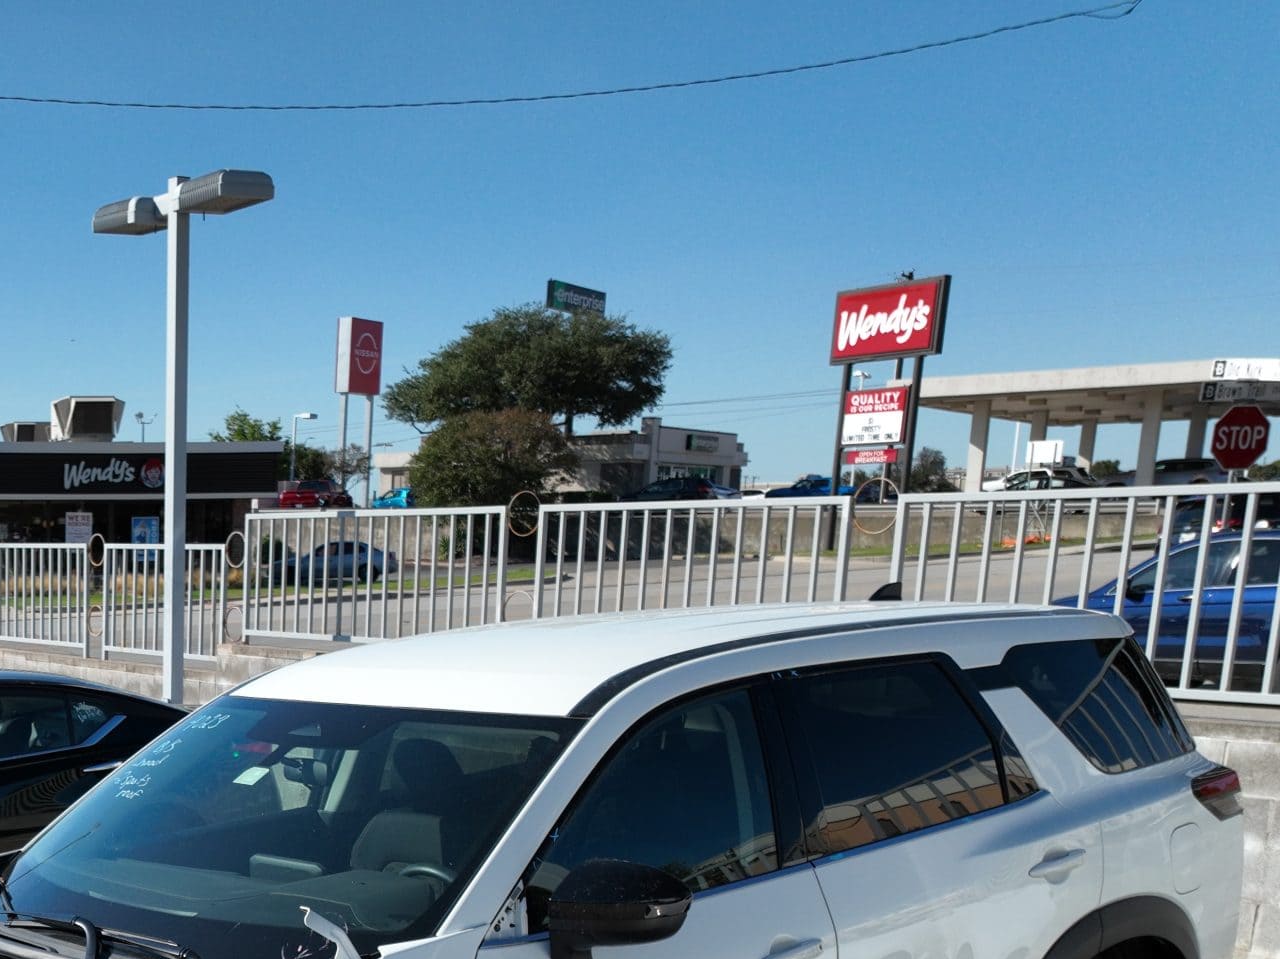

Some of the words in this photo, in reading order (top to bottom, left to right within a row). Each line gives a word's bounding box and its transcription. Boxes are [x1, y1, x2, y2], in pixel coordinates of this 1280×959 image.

[838, 293, 930, 351] Wendy's
[851, 392, 900, 406] QUALITY
[859, 404, 874, 412] OUR
[874, 403, 899, 411] RECIPE
[1215, 426, 1266, 450] STOP
[64, 457, 136, 490] Wendy's
